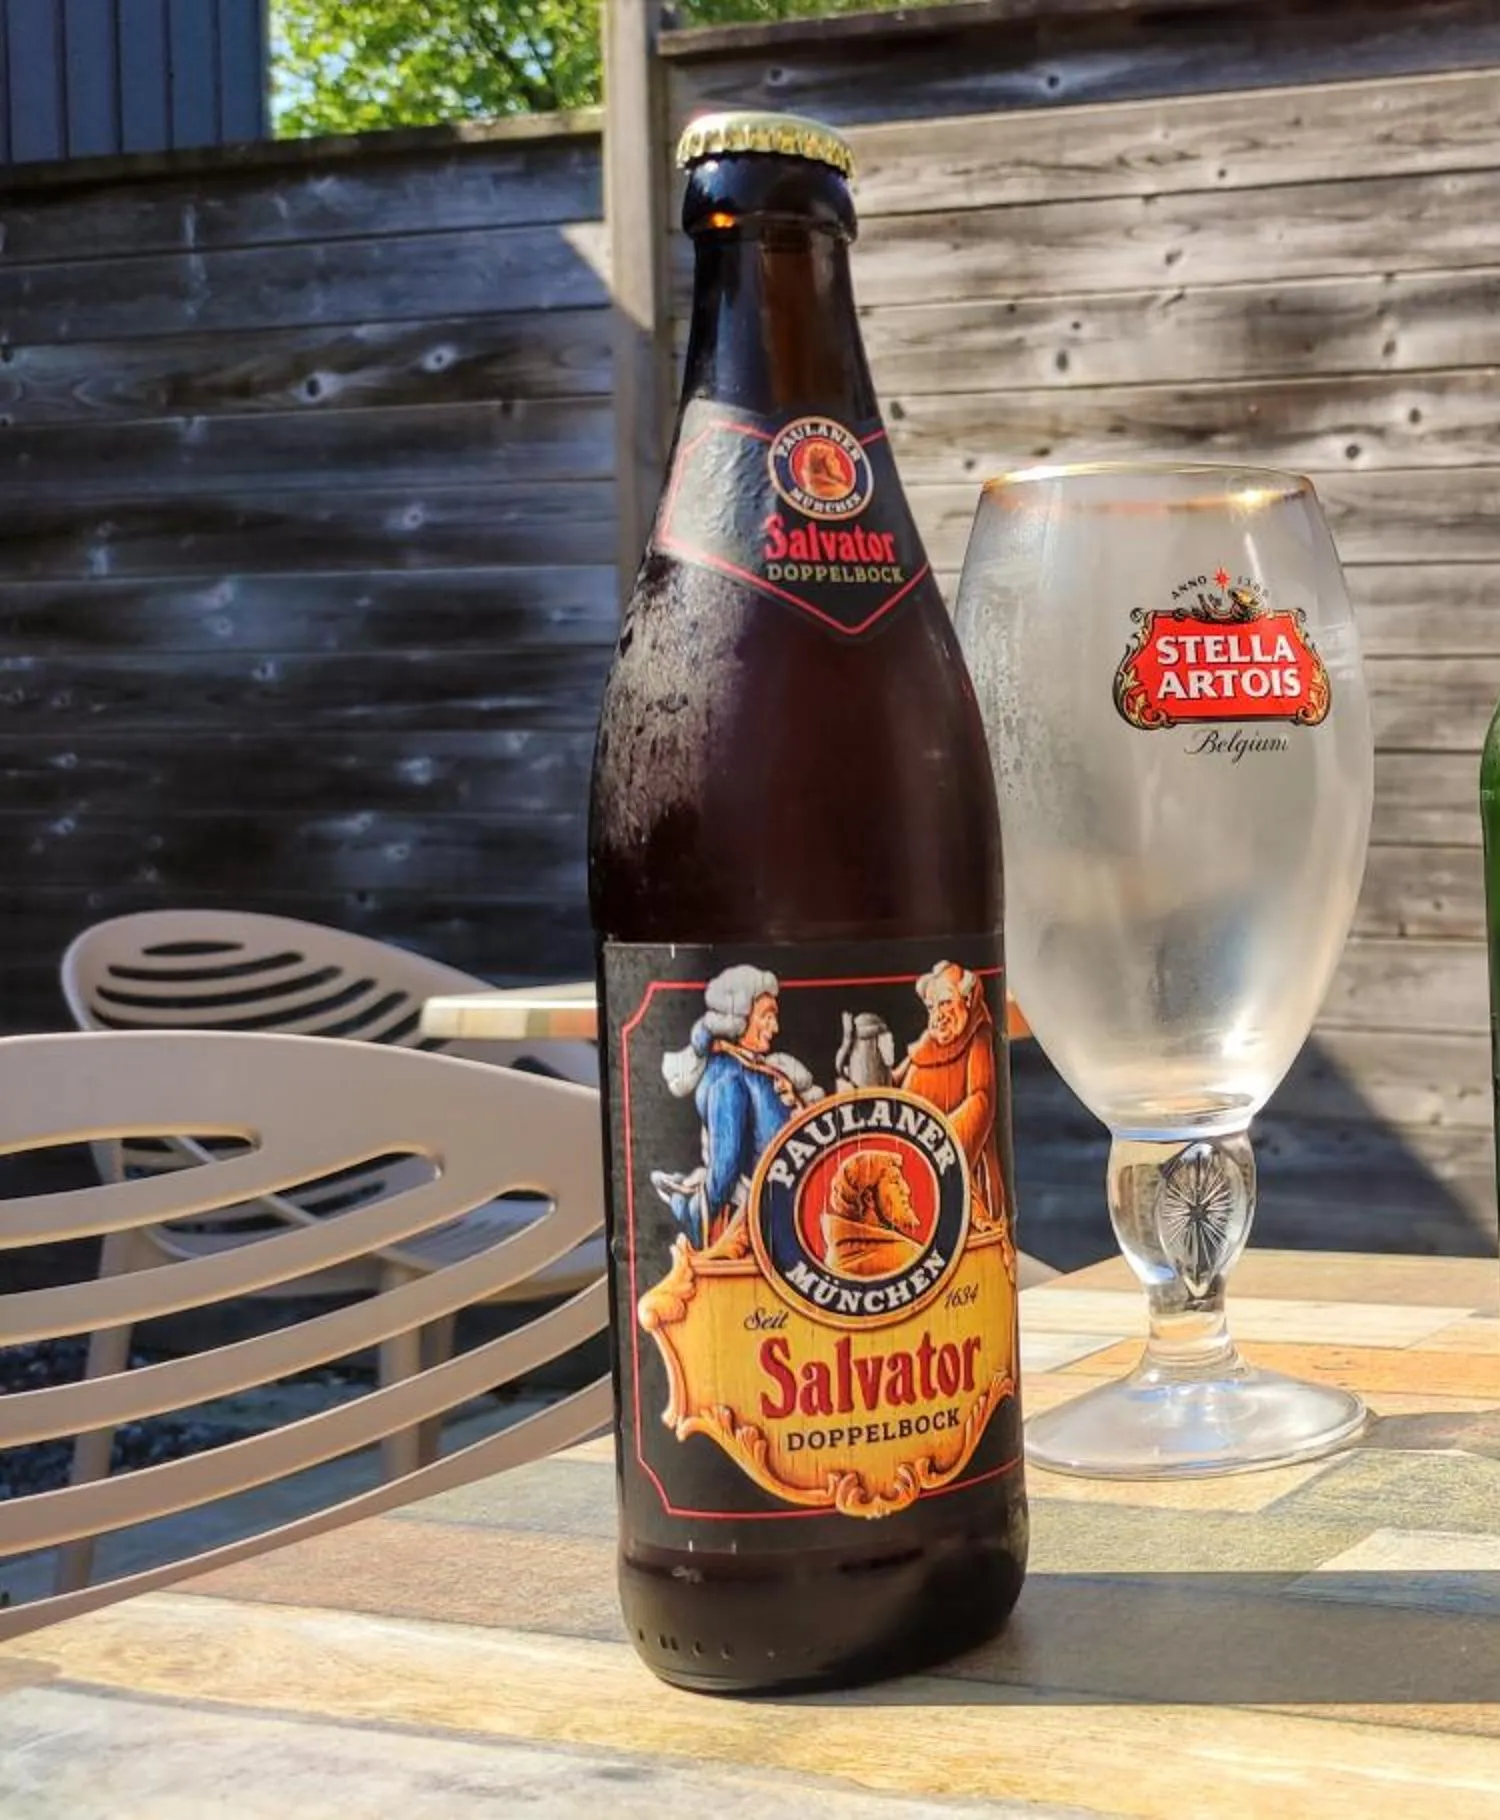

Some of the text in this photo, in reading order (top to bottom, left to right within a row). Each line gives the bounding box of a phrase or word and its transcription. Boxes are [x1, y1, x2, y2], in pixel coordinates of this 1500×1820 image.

[774, 422, 861, 461] PAULANER
[764, 513, 896, 562] Salvator
[767, 564, 904, 583] DOPPELBOCK
[1171, 576, 1207, 600] ANNO
[1155, 634, 1297, 665] STELLA
[1157, 668, 1302, 699] ARTOIS
[1184, 729, 1289, 763] Belgium
[767, 1100, 956, 1189] PAULANER
[785, 1248, 946, 1313] MÜNCHEN
[743, 1307, 789, 1332] Seit
[759, 1336, 981, 1420] Salvator
[787, 1408, 961, 1452] DOPPELBOCK
